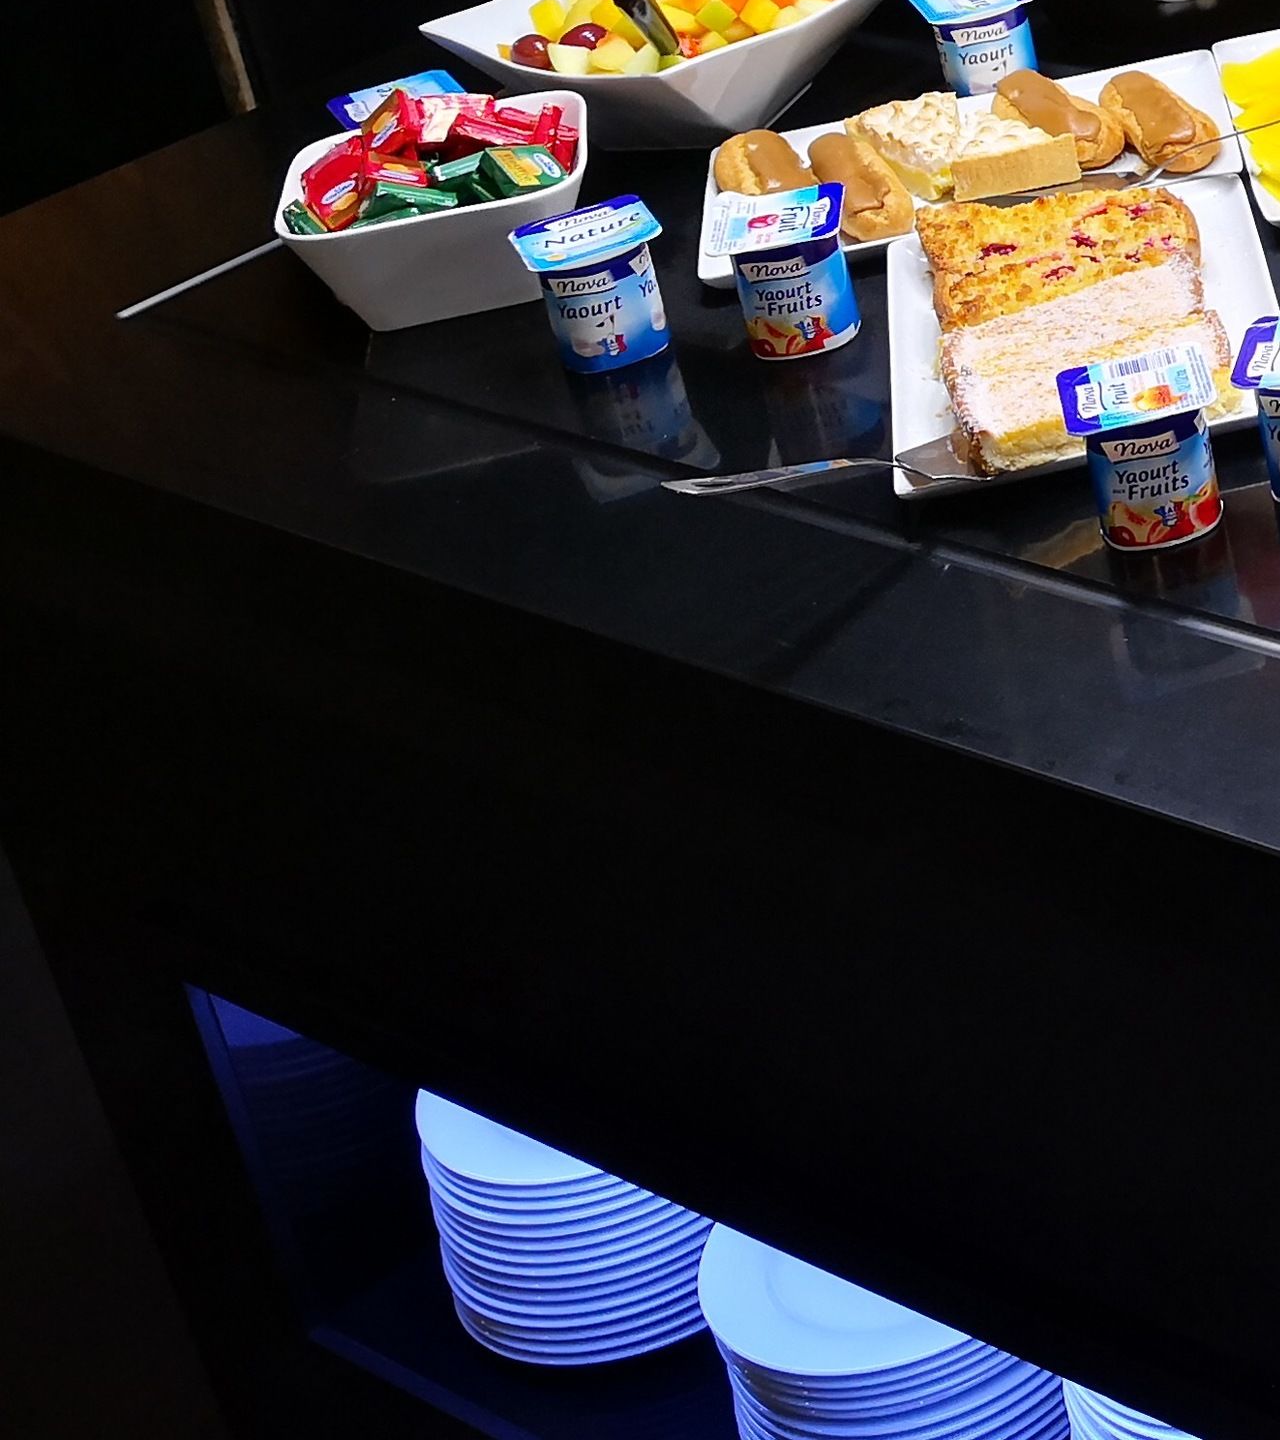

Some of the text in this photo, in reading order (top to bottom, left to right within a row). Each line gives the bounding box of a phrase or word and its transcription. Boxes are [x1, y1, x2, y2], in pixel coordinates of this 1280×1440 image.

[961, 26, 1005, 42] Nova
[959, 43, 1014, 66] Yaourt
[544, 212, 641, 249] Nature
[777, 205, 795, 234] Fruit
[750, 261, 802, 278] Nova
[556, 276, 610, 293] Nova
[756, 281, 812, 303] Yaourt
[558, 295, 622, 320] Yaourt
[767, 295, 822, 316] Fruits
[1112, 382, 1126, 409] Fruit
[1114, 437, 1172, 457] Nova
[1115, 460, 1179, 484] Yaourt
[1128, 473, 1190, 501] Fruits
